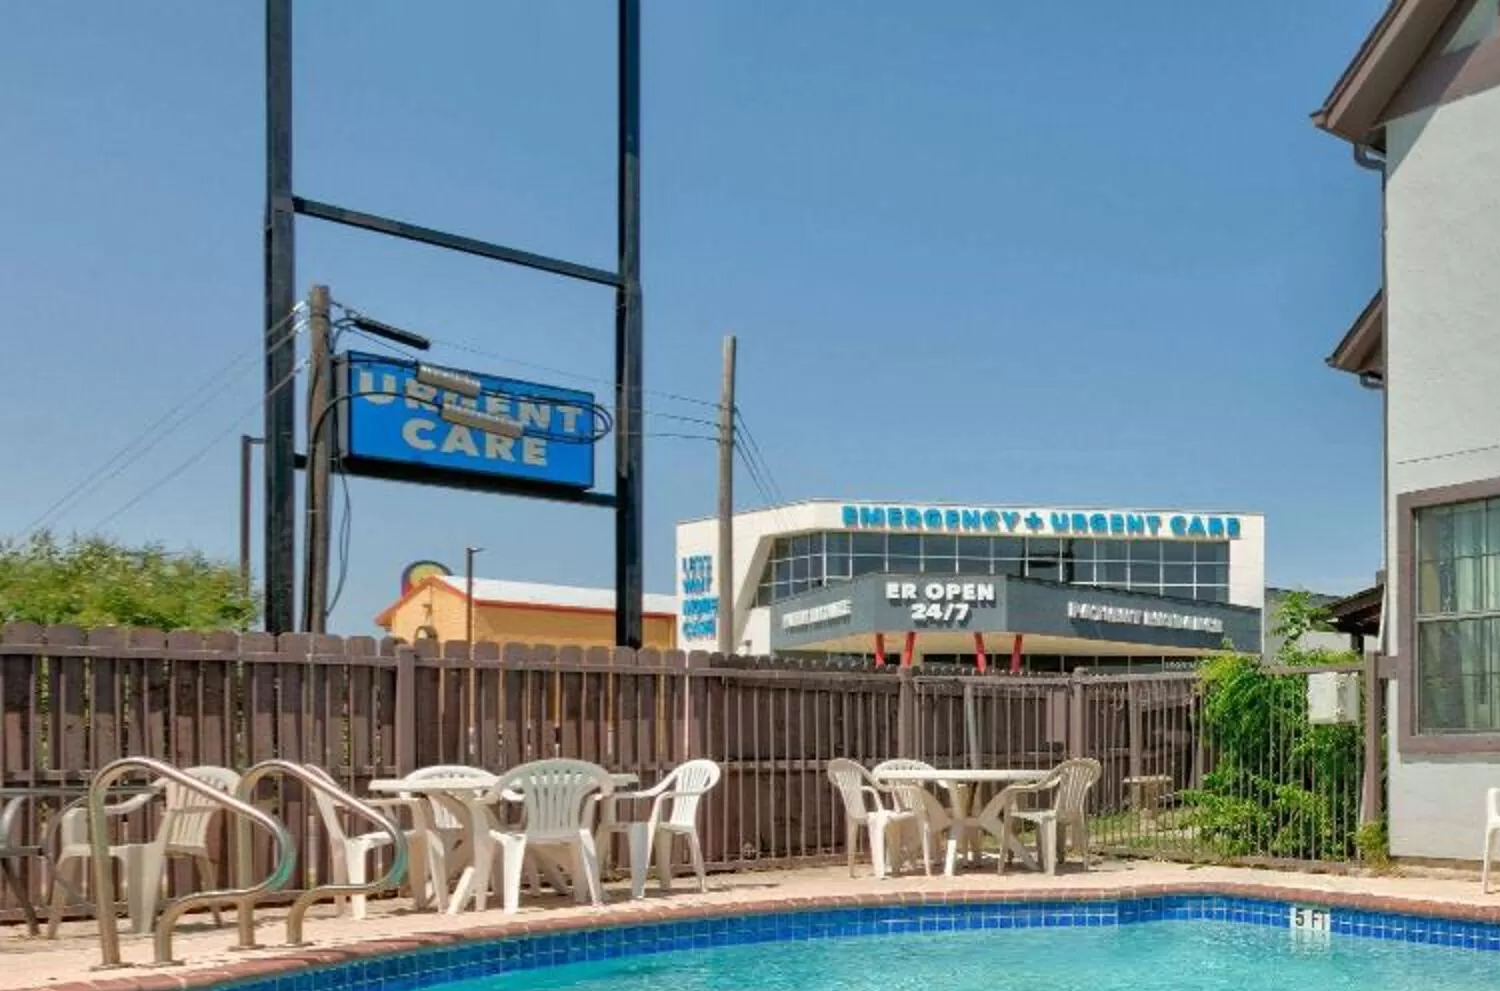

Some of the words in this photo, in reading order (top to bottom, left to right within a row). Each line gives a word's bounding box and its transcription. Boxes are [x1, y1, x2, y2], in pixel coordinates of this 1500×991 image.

[402, 417, 548, 467] CARE
[841, 504, 1020, 534] EMERGENCY
[1050, 511, 1164, 537] URGENT
[1169, 514, 1242, 540] CARE
[885, 581, 918, 600] ER
[924, 581, 995, 601] OPEN
[911, 602, 970, 621] 24/7
[1295, 907, 1305, 927] 5
[1311, 909, 1329, 930] FT
